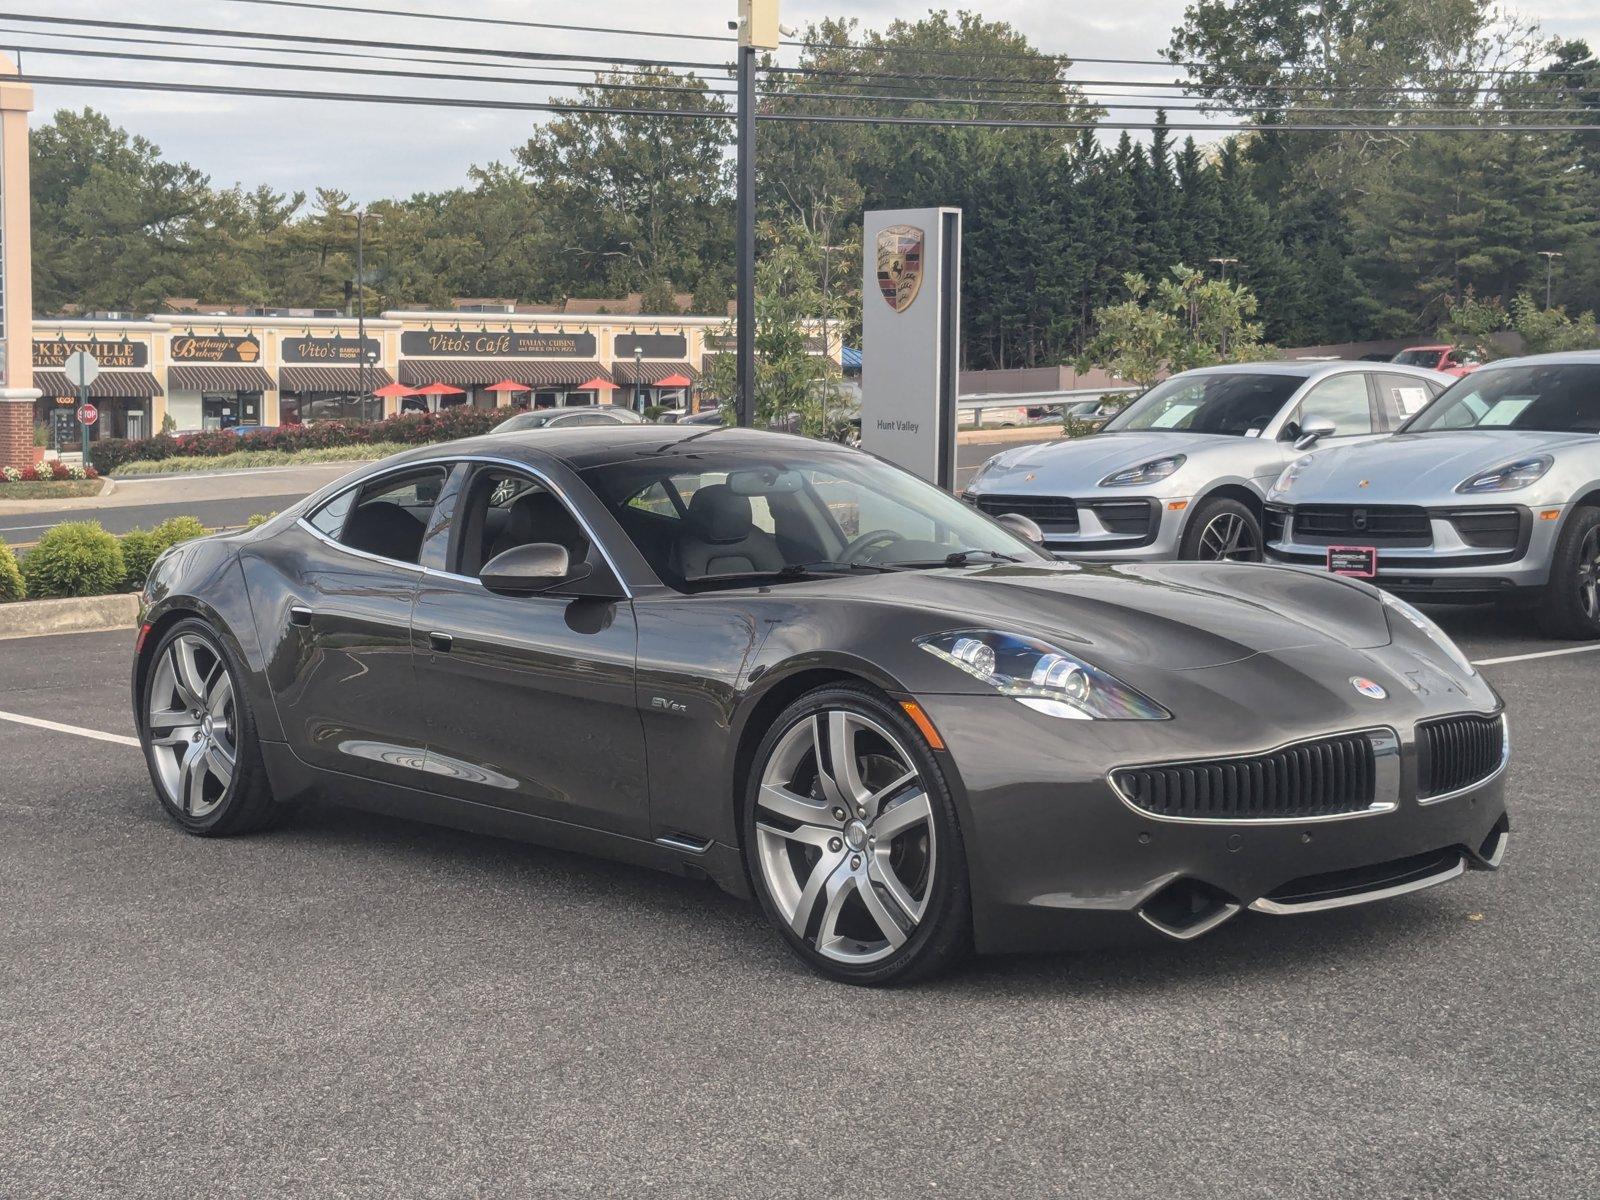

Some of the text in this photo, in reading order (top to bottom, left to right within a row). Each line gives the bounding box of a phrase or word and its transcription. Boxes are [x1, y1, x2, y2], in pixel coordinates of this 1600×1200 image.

[32, 343, 134, 356] CKEYSVILLE
[171, 338, 234, 357] Bethany's
[298, 342, 336, 358] Vito's
[428, 334, 510, 355] Vito's Café
[32, 356, 134, 366] CIANS ECARE
[876, 419, 919, 434] Hunt Valley
